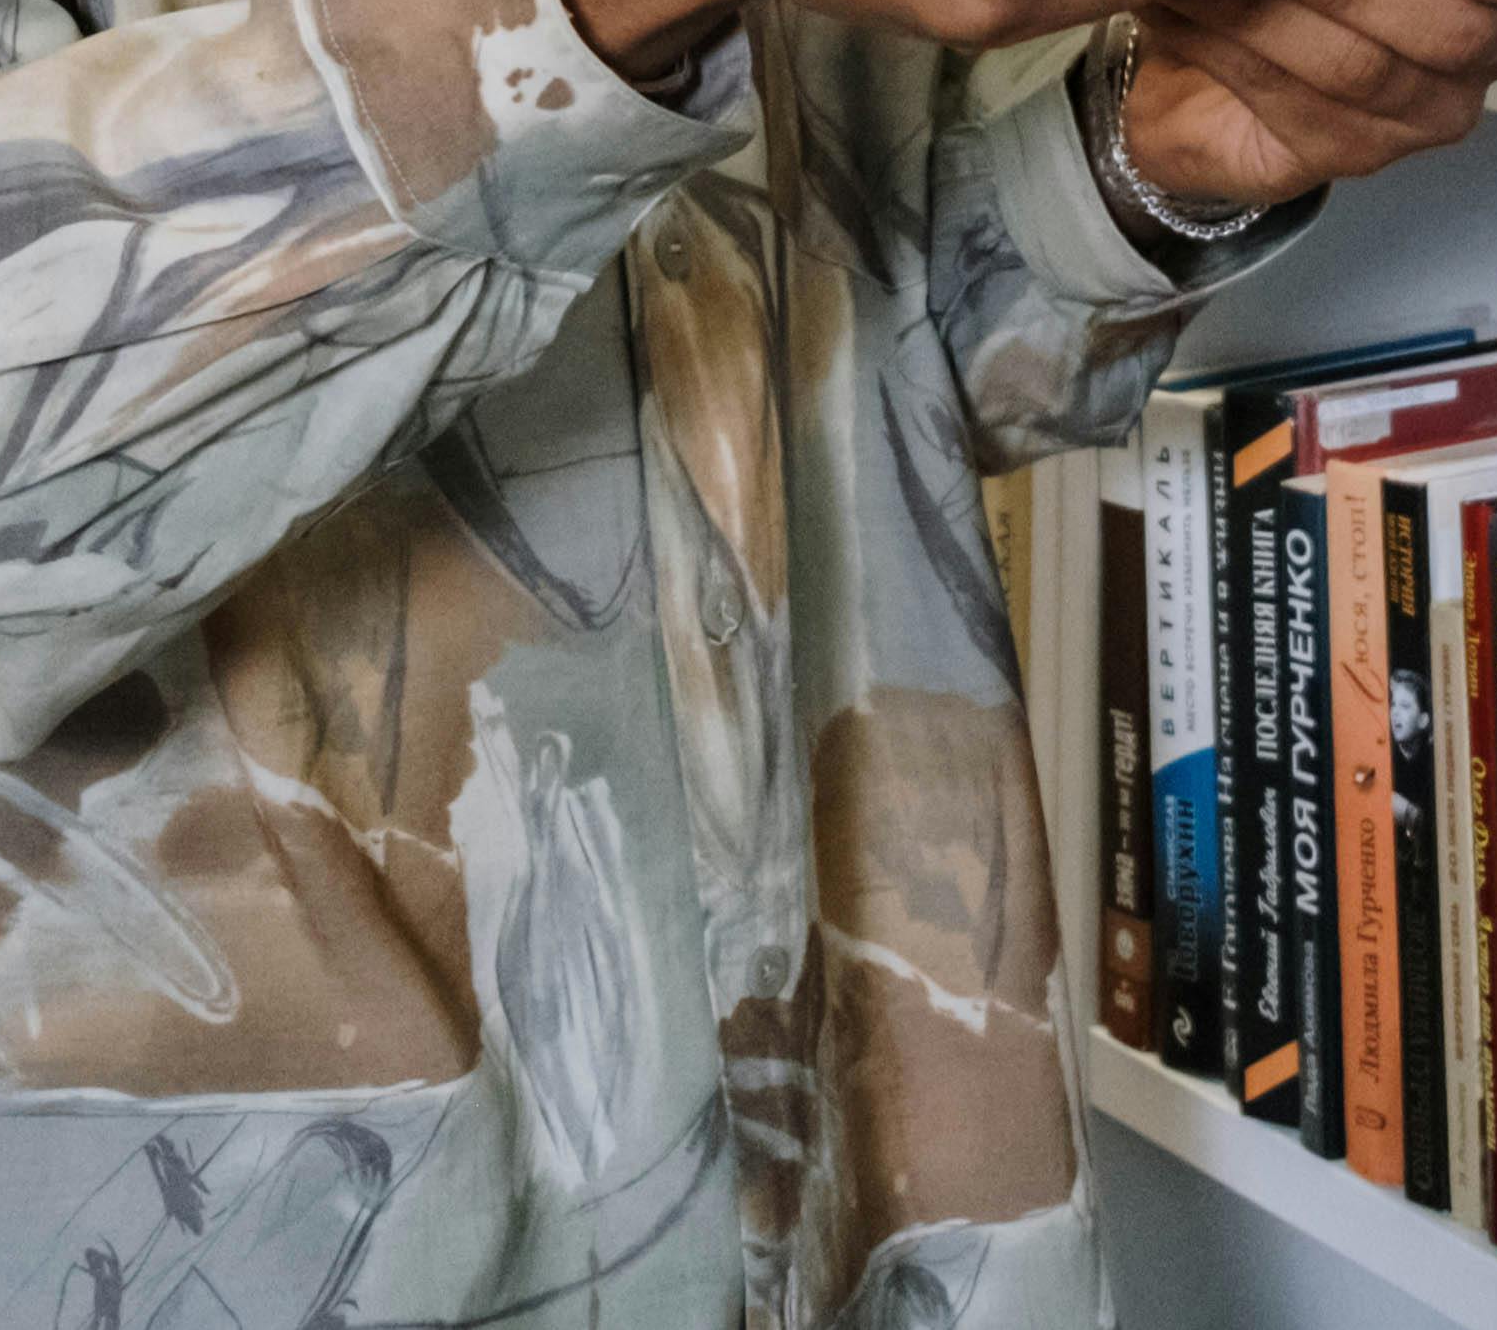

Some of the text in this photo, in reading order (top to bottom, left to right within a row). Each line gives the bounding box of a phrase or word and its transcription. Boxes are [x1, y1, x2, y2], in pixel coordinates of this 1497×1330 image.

[1155, 445, 1176, 737] ВЕРТИКАЛЬ
[1249, 507, 1279, 763] ПОСЛЕДНЯЯ КНИГА
[1286, 528, 1322, 917] МОЯ ГУРЧЕНКО
[1355, 817, 1383, 1084] Людмила Гурченко
